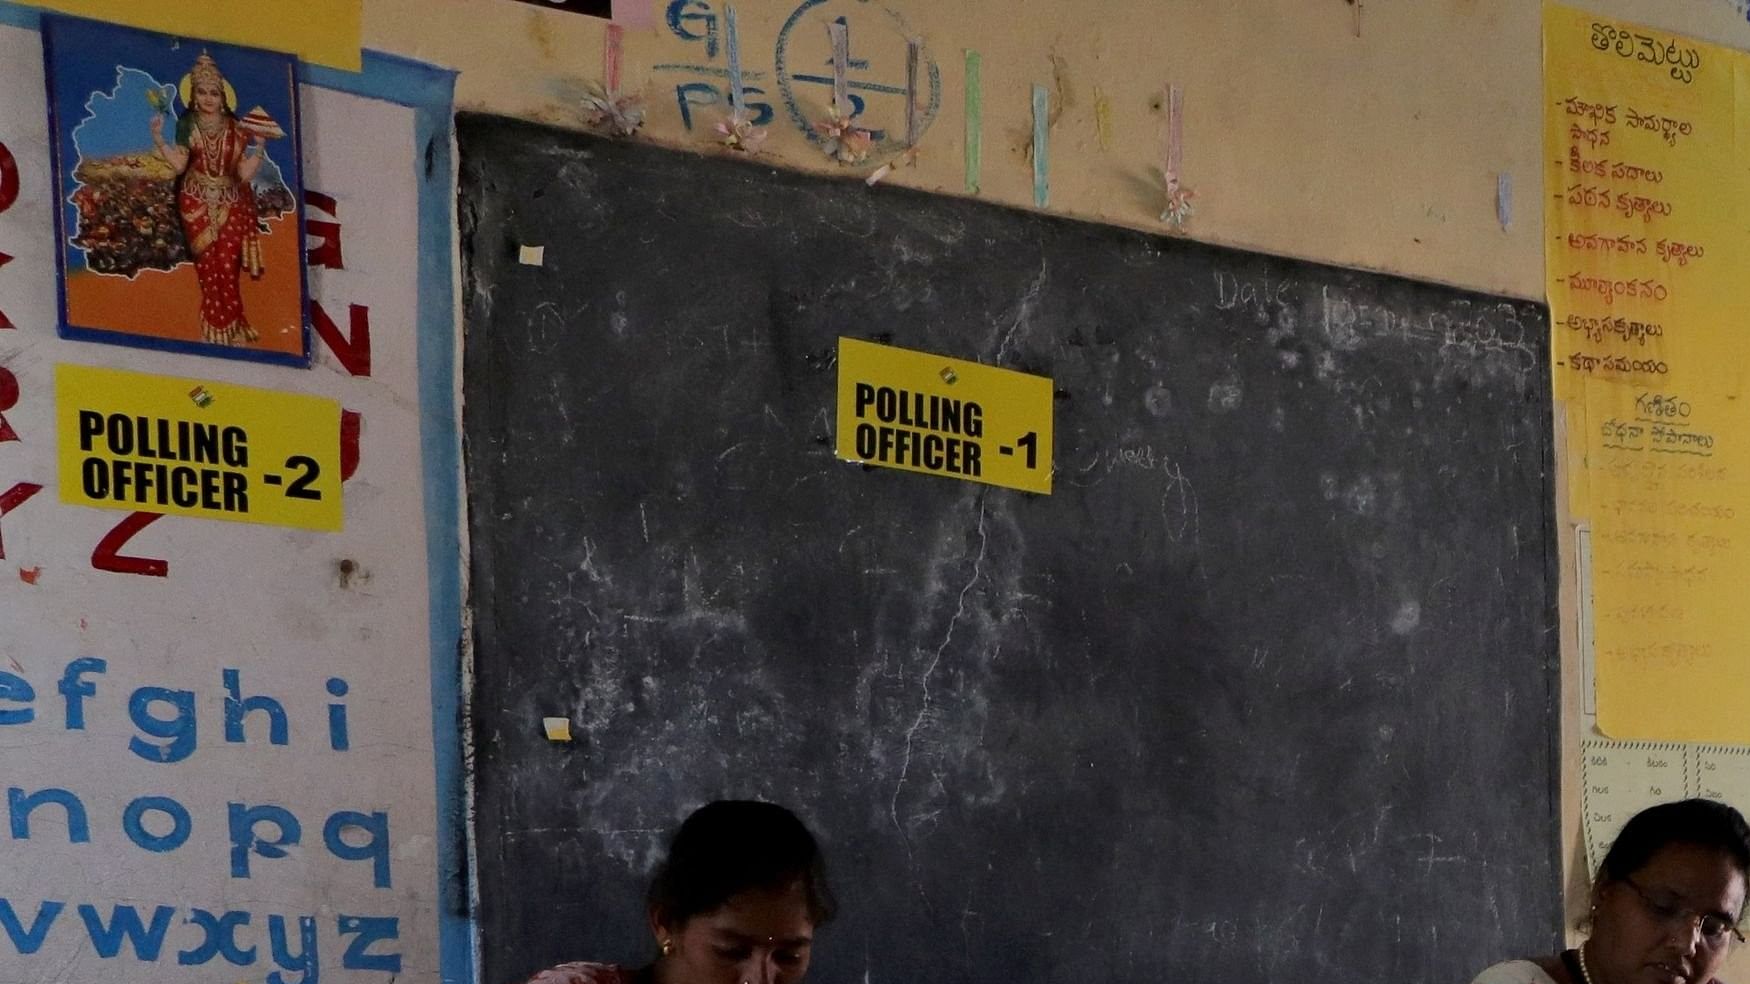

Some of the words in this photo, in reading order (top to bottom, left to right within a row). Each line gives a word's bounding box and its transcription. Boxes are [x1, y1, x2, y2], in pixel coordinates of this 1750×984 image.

[856, 382, 983, 439] POLLING
[79, 410, 248, 469] POLLING
[856, 422, 982, 477] OFFICER
[82, 456, 249, 514] OFFICER
